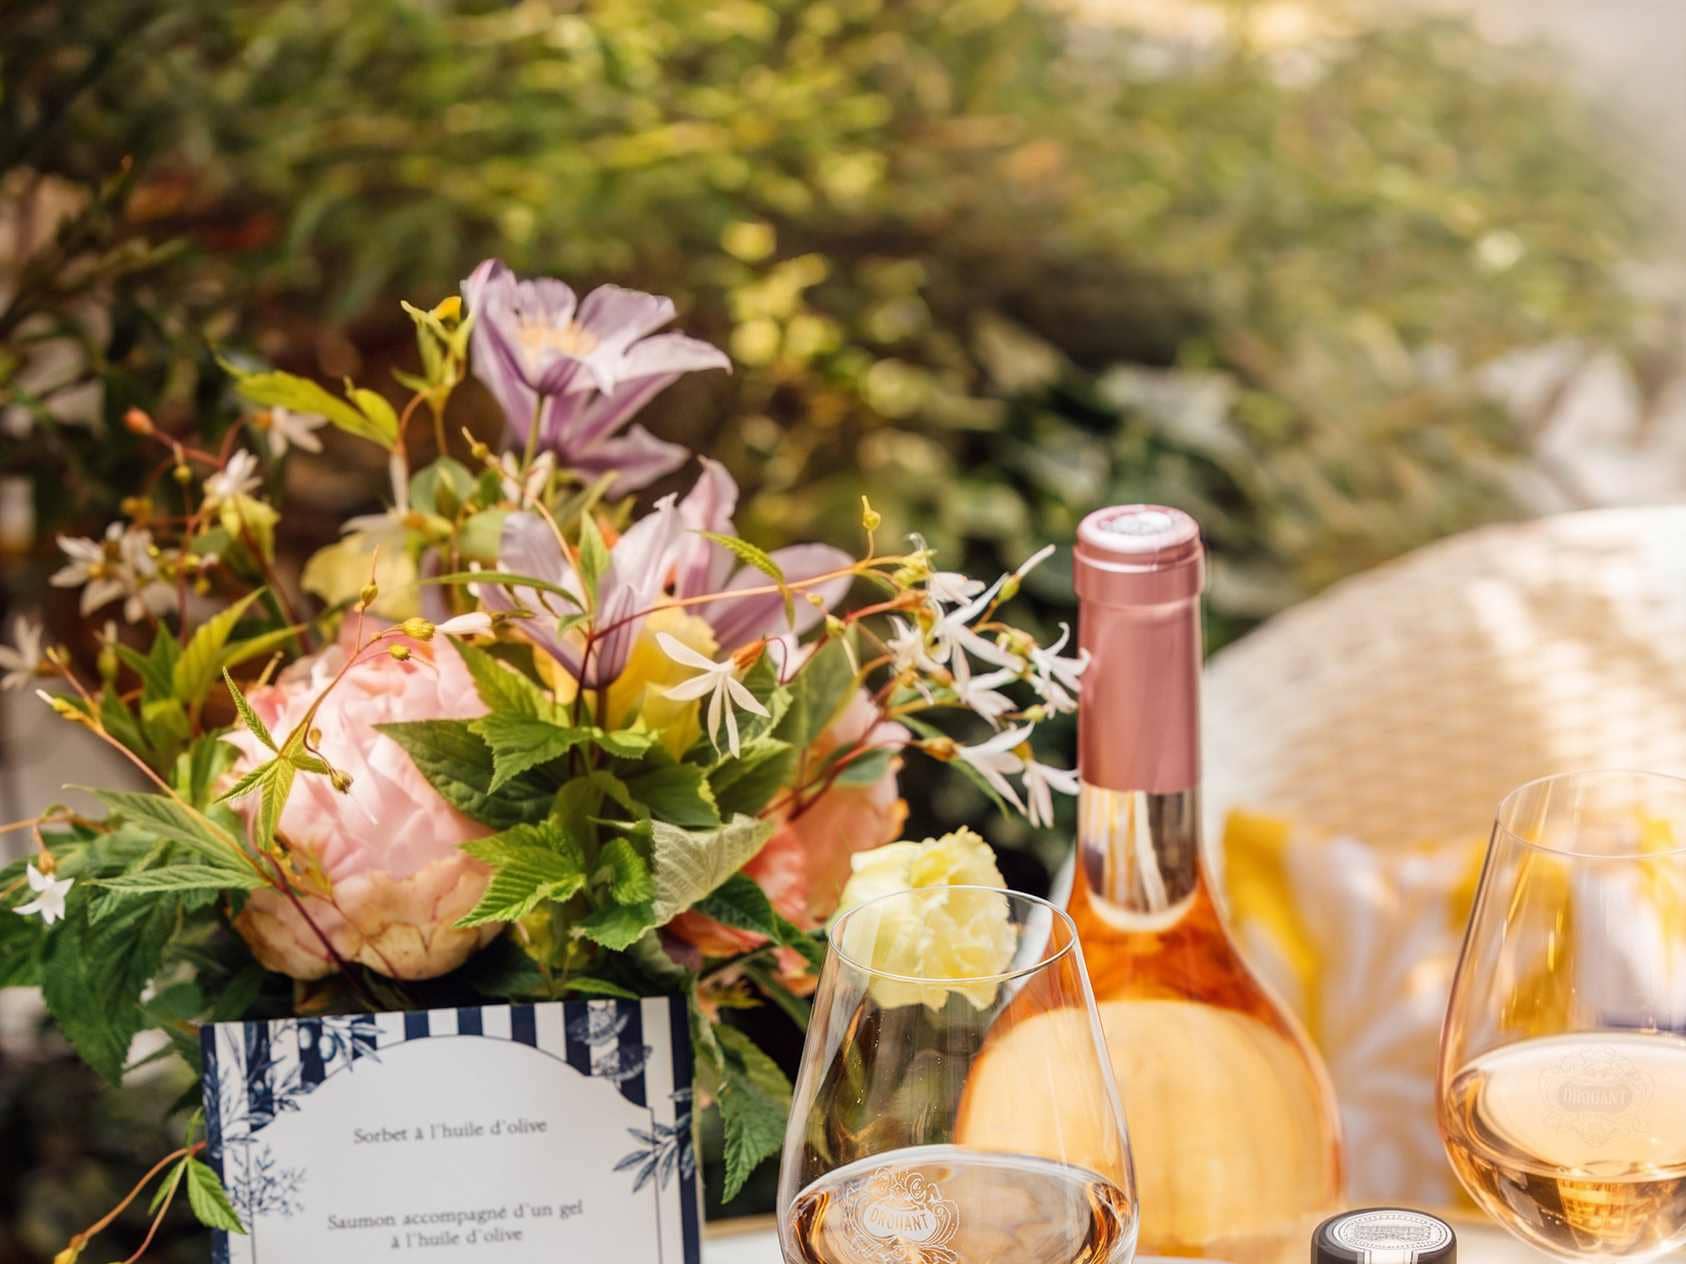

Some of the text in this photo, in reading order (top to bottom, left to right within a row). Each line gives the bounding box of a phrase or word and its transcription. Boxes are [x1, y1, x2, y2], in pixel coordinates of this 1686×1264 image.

[353, 1127, 407, 1144] Sorbet
[414, 1124, 424, 1140] à
[328, 1213, 396, 1230] Saumon
[402, 1207, 507, 1227] accompagné
[559, 1199, 583, 1219] gel
[391, 1234, 400, 1249] à
